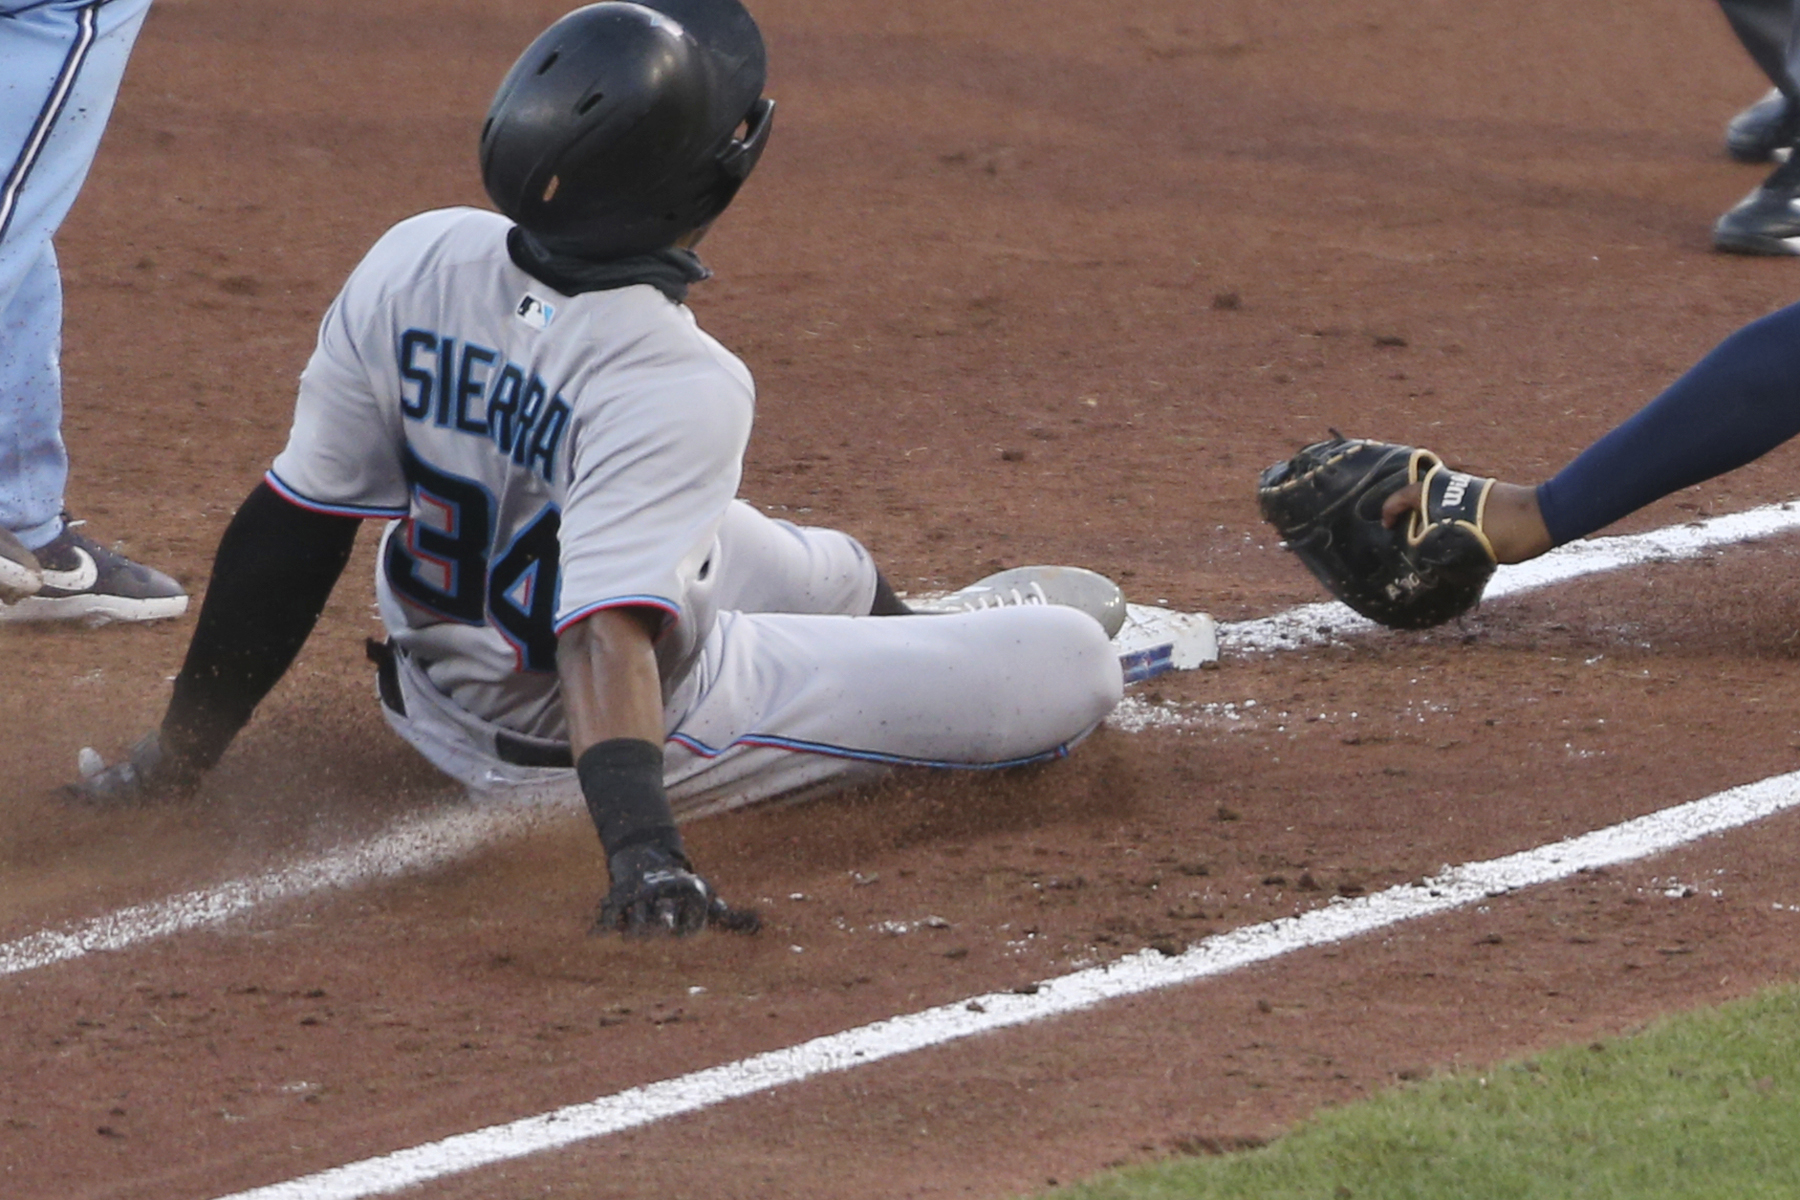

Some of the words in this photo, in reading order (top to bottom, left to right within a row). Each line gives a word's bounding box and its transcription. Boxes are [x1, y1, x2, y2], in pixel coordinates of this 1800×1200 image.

[401, 327, 572, 484] SIERRA
[384, 442, 562, 673] 34
[1441, 474, 1472, 507] Wil
